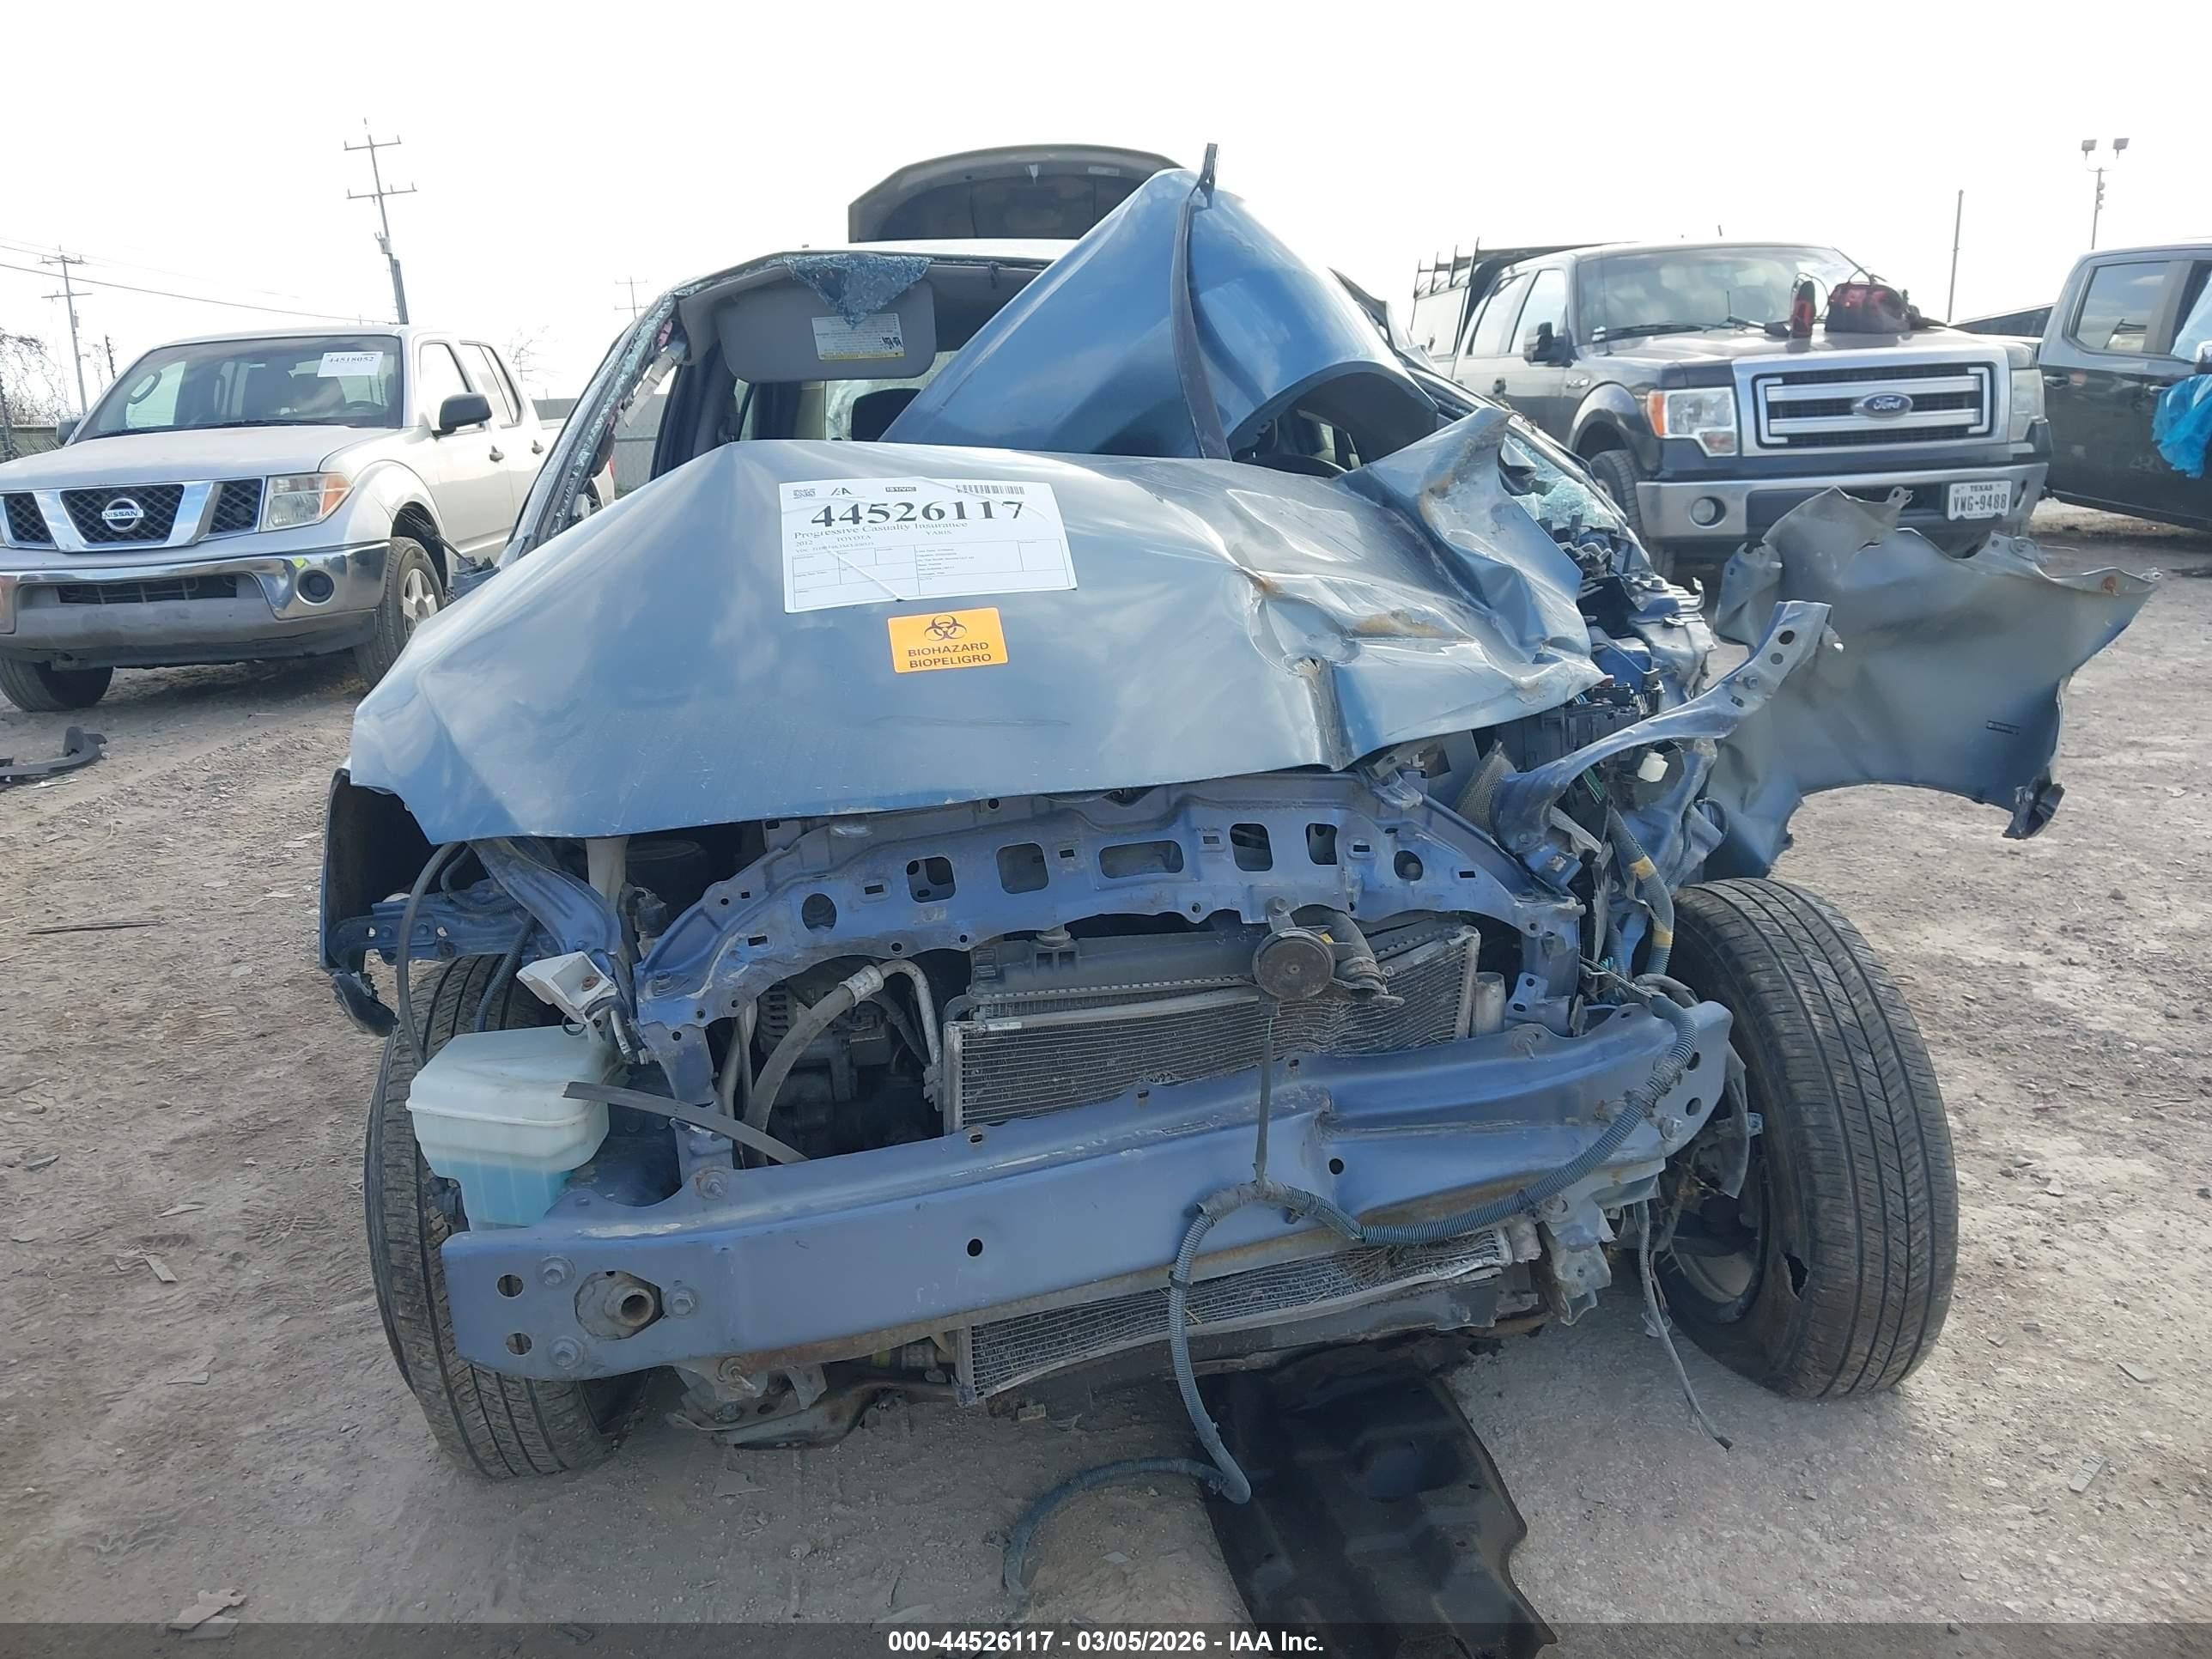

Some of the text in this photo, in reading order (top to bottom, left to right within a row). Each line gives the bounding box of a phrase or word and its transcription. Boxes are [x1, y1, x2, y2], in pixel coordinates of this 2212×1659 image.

[1873, 397, 1902, 410] Ford
[811, 501, 1024, 527] 44526117
[794, 520, 969, 539] Progressive Casualty Insurance
[908, 641, 989, 658] BIOHAZARD
[909, 653, 992, 669] BIOPELIGRO
